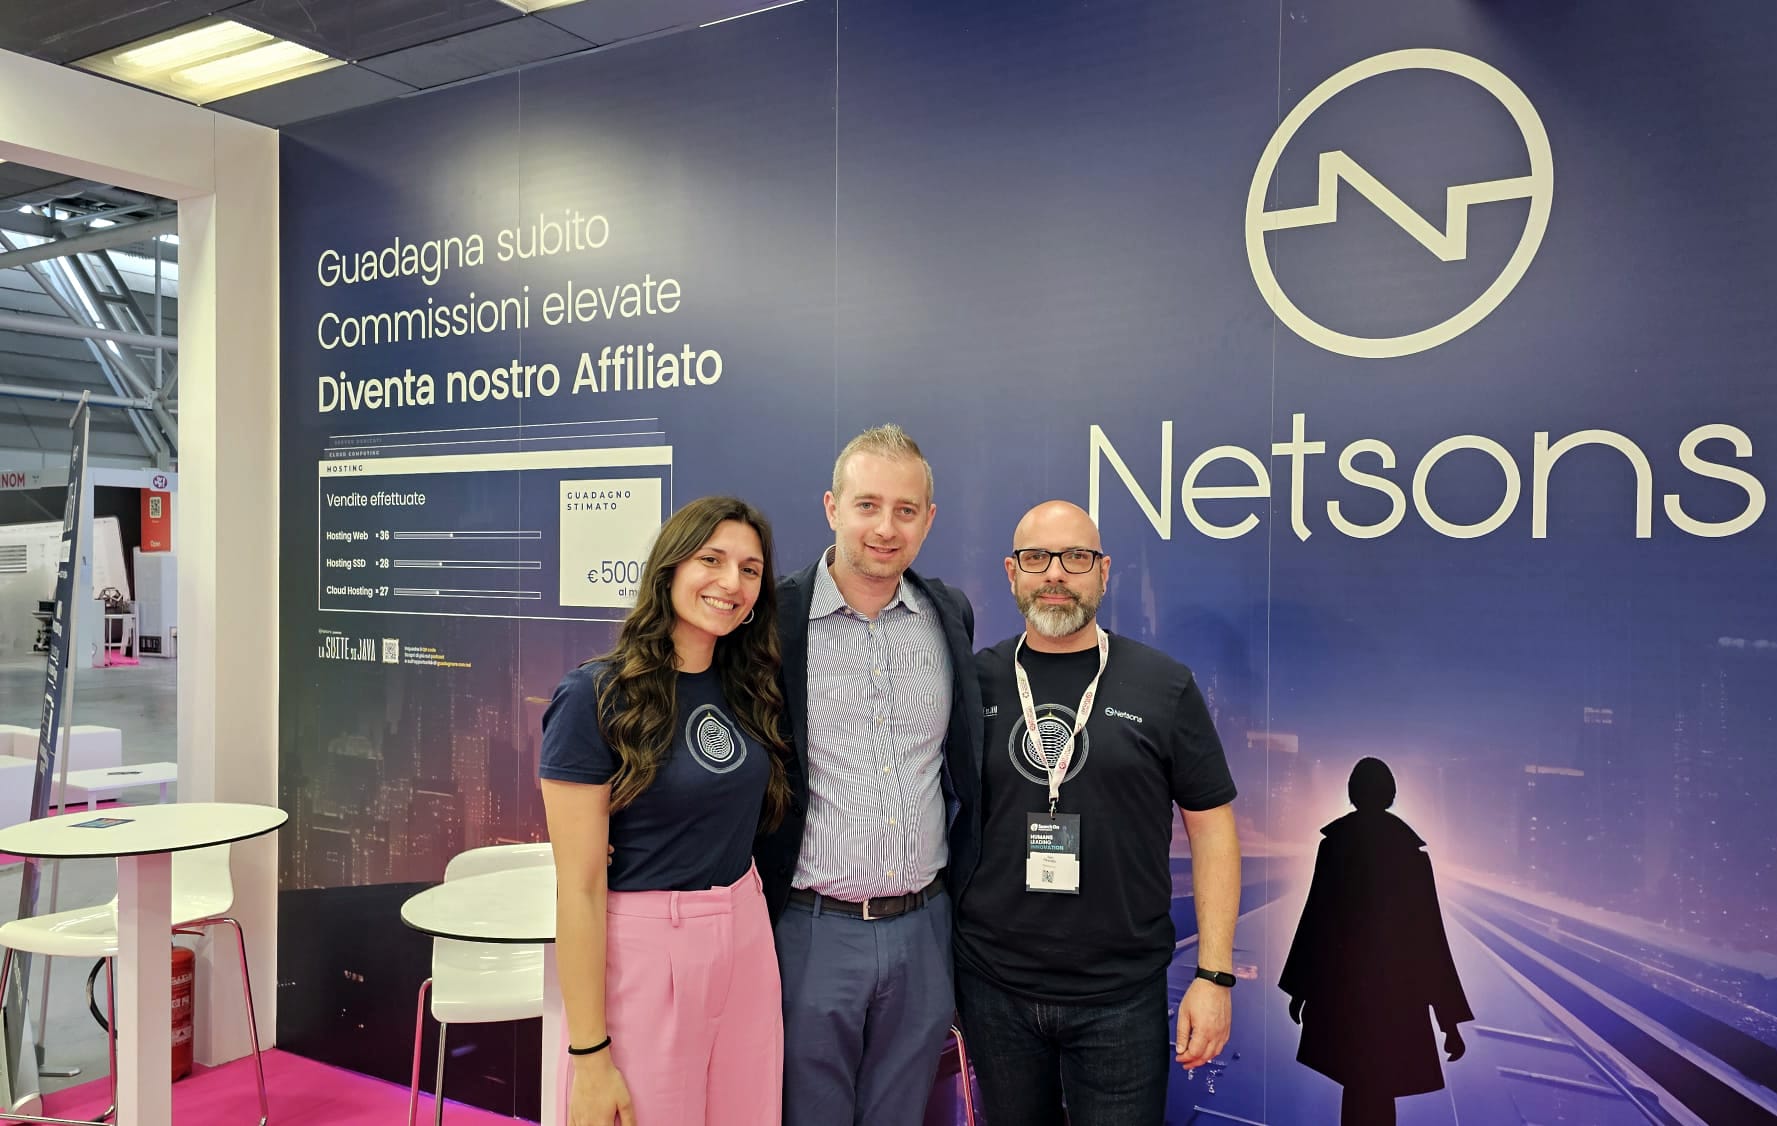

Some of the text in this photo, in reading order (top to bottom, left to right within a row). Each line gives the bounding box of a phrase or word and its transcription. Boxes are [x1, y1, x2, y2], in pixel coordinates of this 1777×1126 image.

[318, 208, 610, 286] Guadagna subito
[318, 274, 681, 350] Commissioni elevate
[318, 343, 723, 413] Diventa nostro Affiliato
[1089, 413, 1767, 542] Netsons
[326, 491, 426, 507] Vendite effettuate
[567, 490, 631, 499] GUADAGNO
[567, 502, 617, 511] STIMATO
[326, 530, 390, 543] Hosting Web 36
[326, 558, 390, 570] Hosting SSD 28
[326, 585, 389, 599] Cloud Hosting 27
[618, 587, 627, 597] al
[325, 636, 350, 660] SUITE
[357, 638, 376, 662] JAVA
